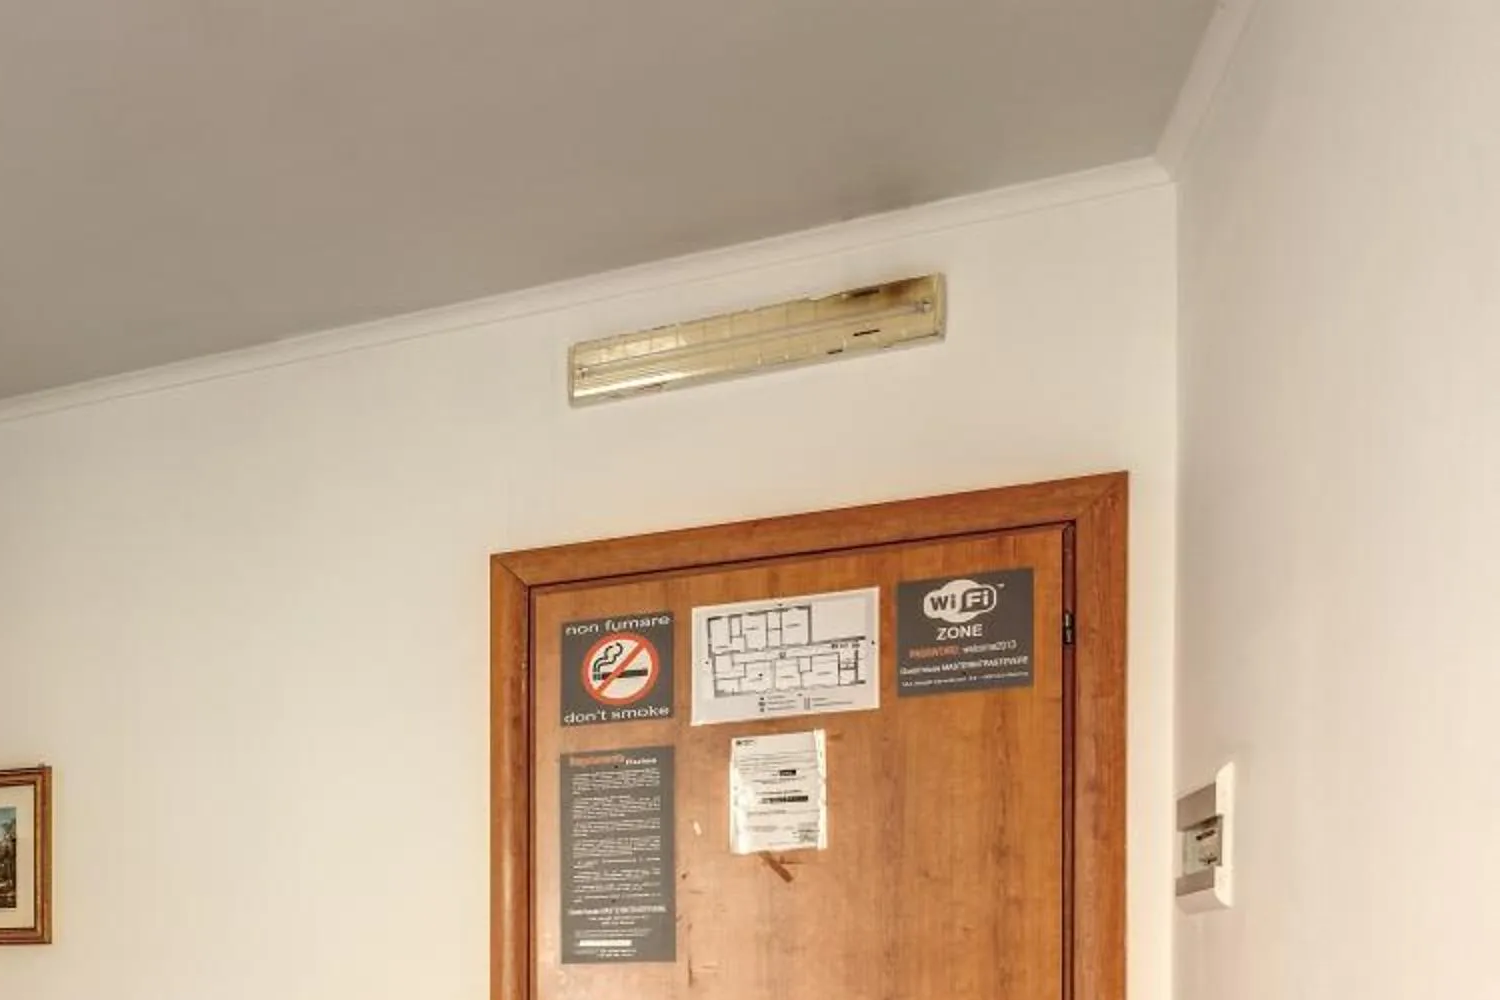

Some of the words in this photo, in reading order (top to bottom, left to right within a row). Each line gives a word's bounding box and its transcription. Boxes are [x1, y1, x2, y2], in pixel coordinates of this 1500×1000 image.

[565, 623, 599, 636] non
[605, 615, 671, 632] fumare
[936, 623, 983, 641] ZONE
[563, 709, 607, 723] don't
[611, 705, 670, 719] smoke
